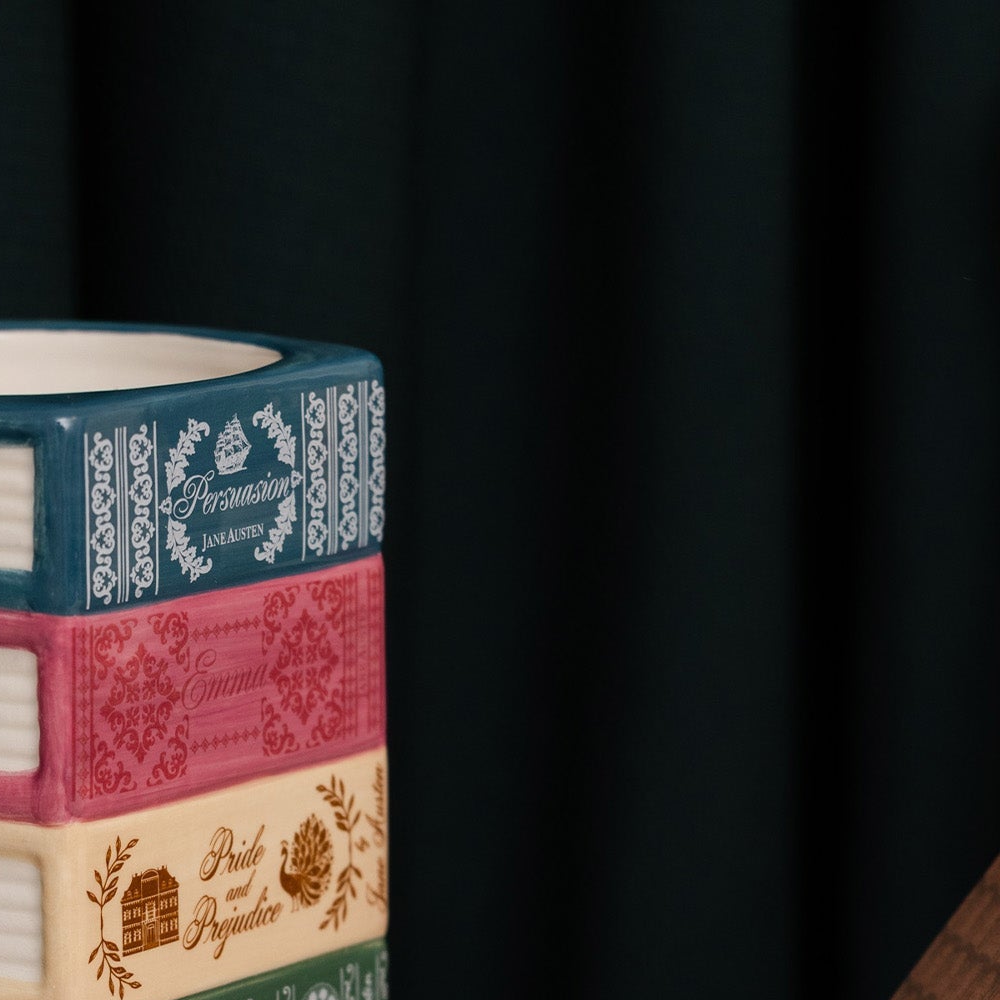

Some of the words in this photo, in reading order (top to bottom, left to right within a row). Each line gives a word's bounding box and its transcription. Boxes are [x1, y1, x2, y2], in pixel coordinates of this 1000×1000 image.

[173, 470, 290, 520] Persuasion
[202, 531, 227, 553] JANE
[227, 522, 265, 544] AUSTEN
[181, 648, 268, 710] Emma
[199, 824, 266, 882] Pride
[225, 869, 257, 902] and
[183, 886, 283, 960] Prejudice
